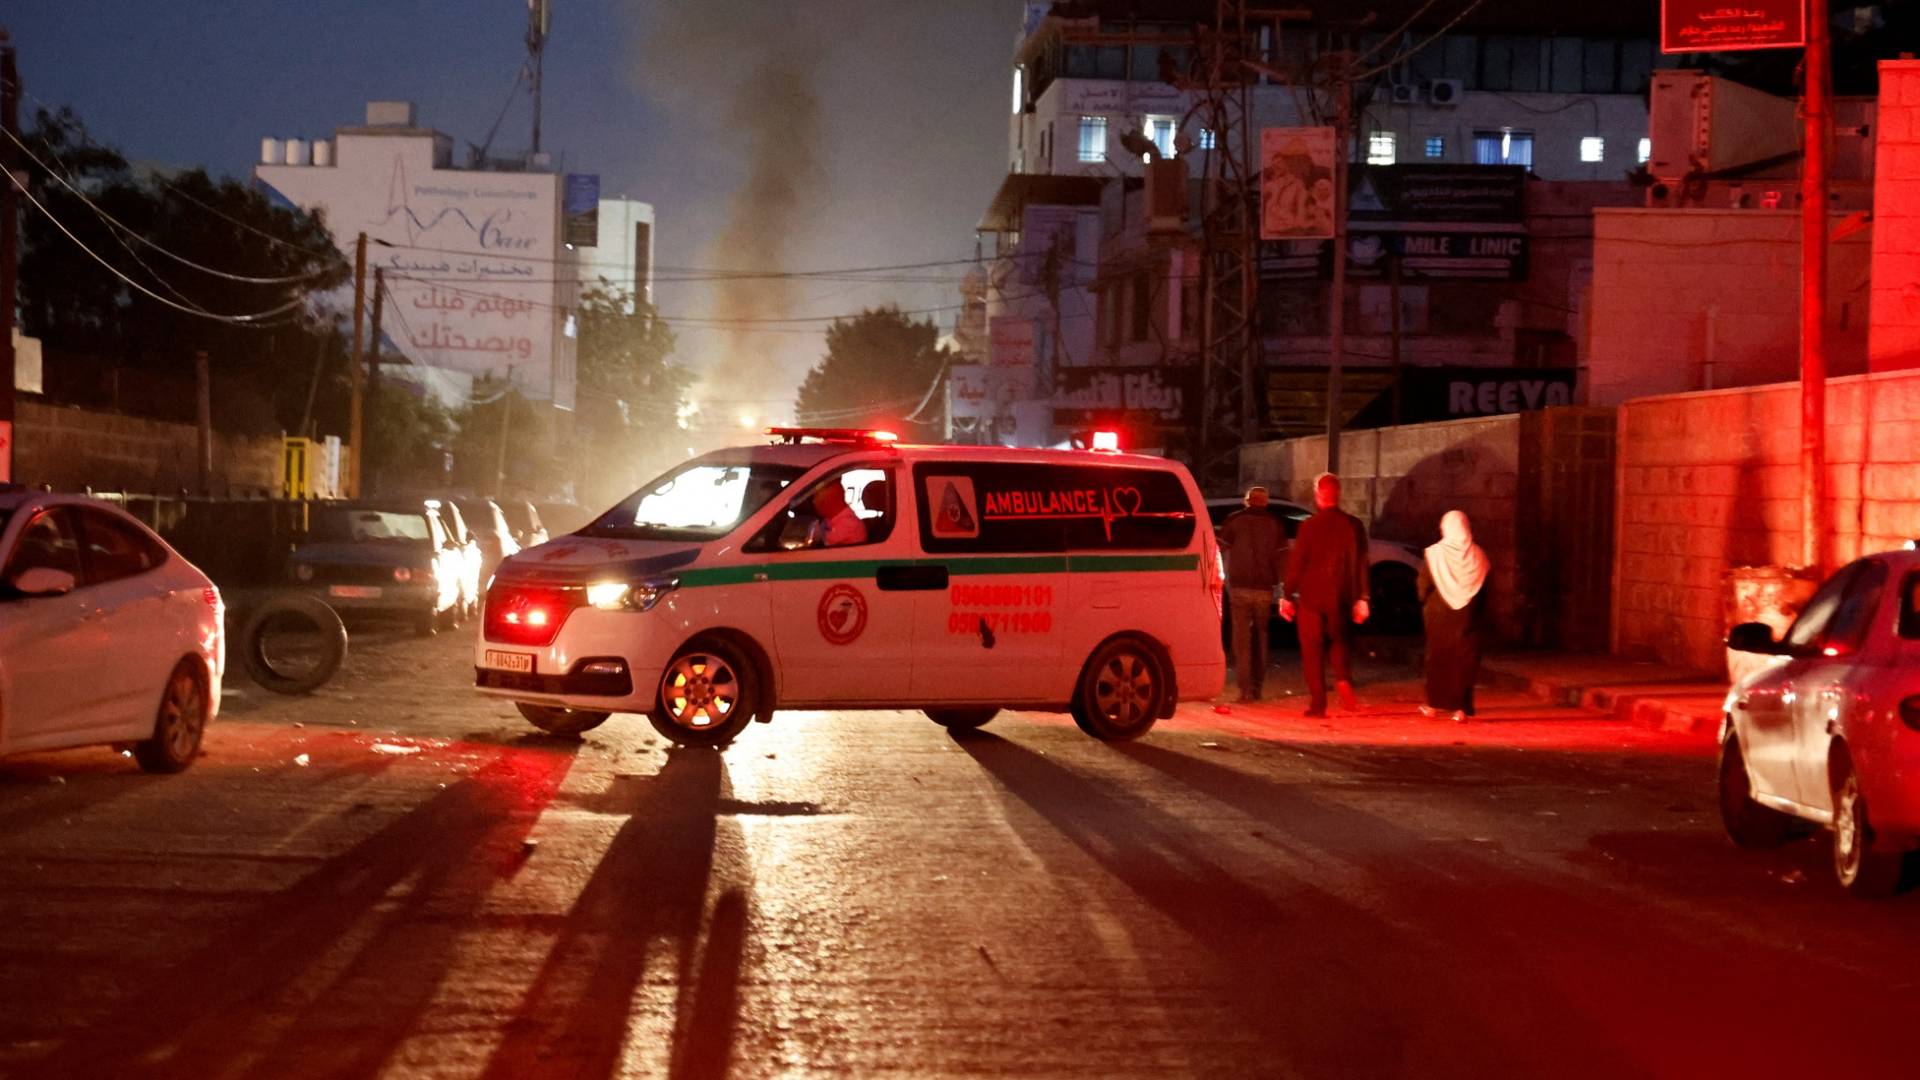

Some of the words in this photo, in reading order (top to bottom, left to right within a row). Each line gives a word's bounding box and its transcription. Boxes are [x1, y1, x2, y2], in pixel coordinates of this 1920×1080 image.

[1393, 235, 1450, 255] MILE
[1456, 236, 1522, 257] LINIC
[985, 490, 1099, 514] AMBULANCE
